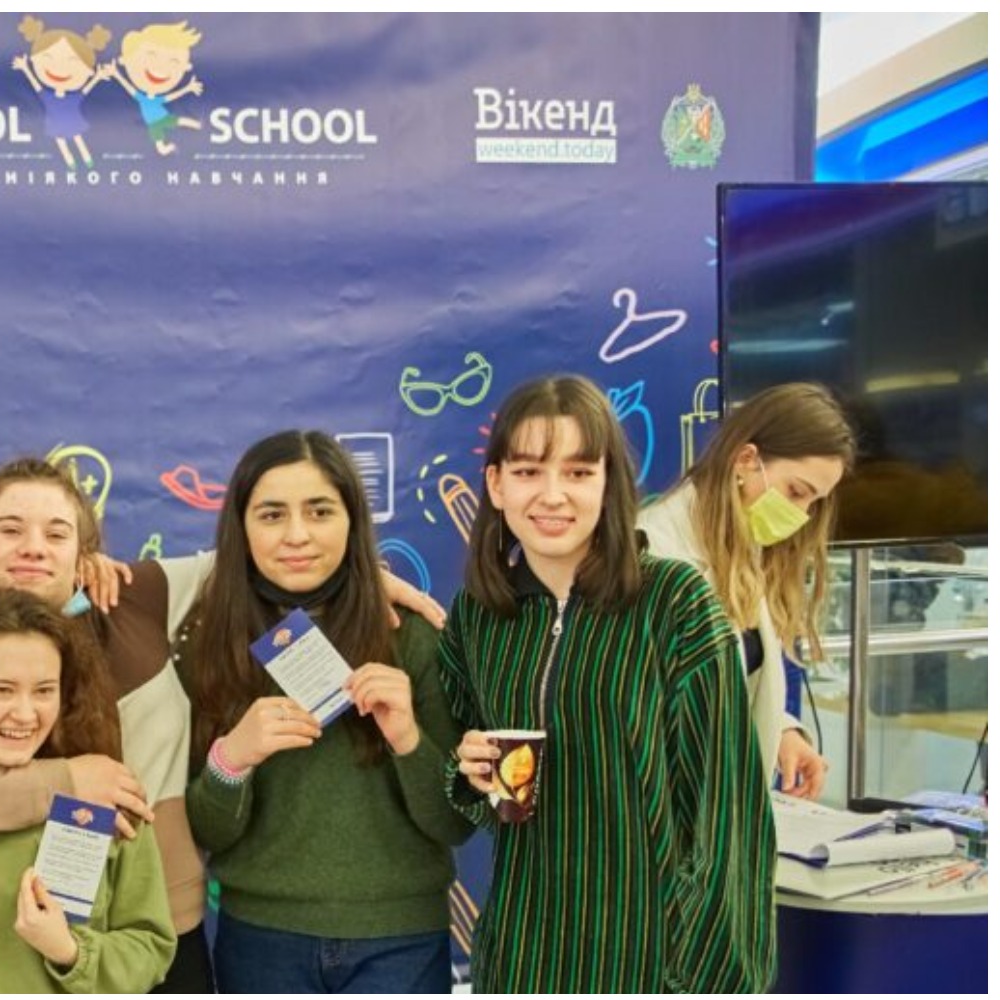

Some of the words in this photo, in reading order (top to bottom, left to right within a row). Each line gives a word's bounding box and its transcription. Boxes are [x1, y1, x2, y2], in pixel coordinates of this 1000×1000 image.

[209, 107, 378, 144] SCHOOL
[474, 87, 617, 136] Вікенд
[477, 139, 616, 162] weekend.today
[5, 170, 142, 186] НІЯКОГО
[168, 170, 328, 186] НАВЧАННЯ
